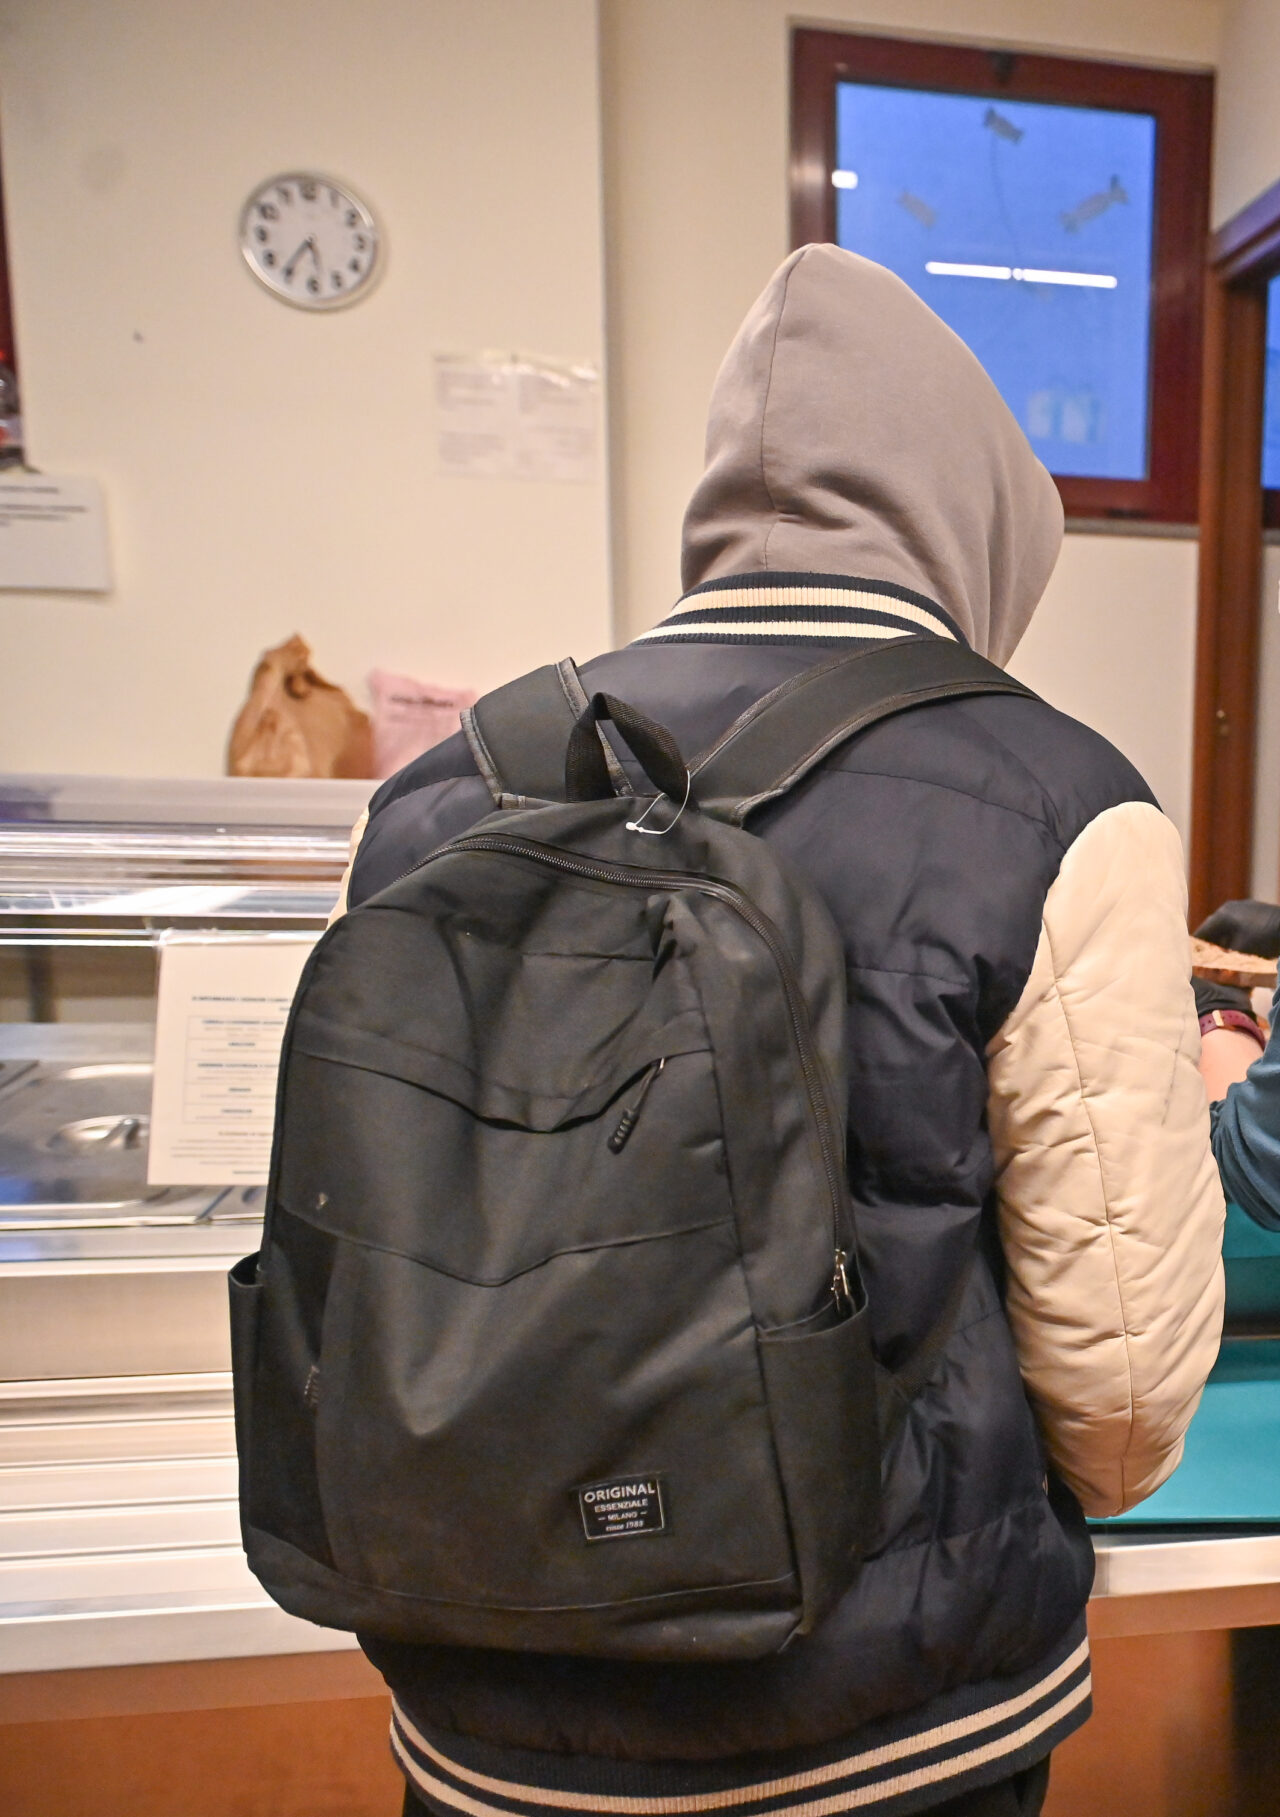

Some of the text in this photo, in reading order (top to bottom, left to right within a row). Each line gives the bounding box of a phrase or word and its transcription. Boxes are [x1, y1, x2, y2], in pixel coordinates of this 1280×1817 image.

[584, 1483, 656, 1503] ORIGINAL
[594, 1498, 648, 1513] ESSENZIALE
[607, 1511, 638, 1521] MILANO
